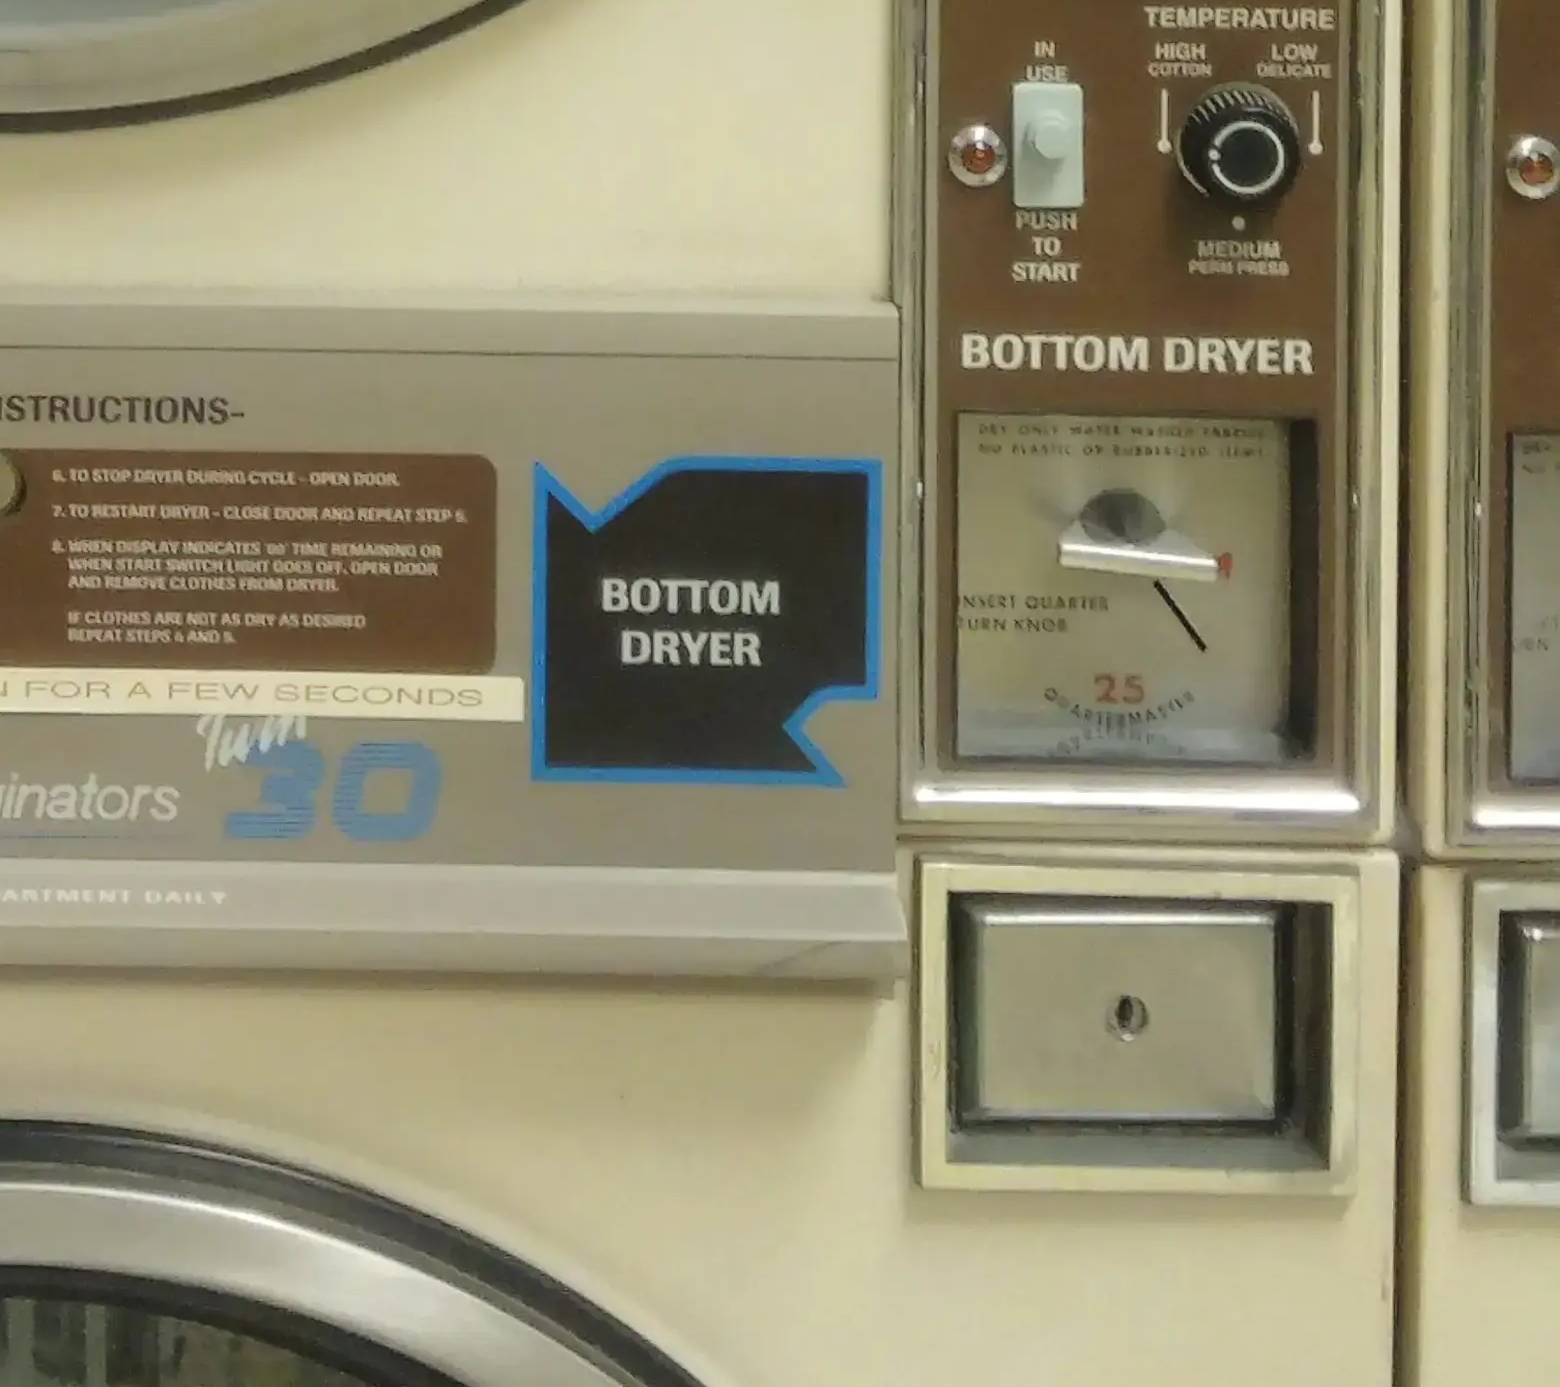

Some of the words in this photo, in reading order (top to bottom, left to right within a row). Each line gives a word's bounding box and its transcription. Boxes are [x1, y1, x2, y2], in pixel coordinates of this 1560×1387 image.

[1144, 6, 1335, 30] TEMPERATURE
[1034, 40, 1055, 58] IN
[1154, 42, 1206, 60] HIGH
[1271, 43, 1318, 61] LOW
[1025, 64, 1069, 83] USE
[1147, 62, 1212, 77] COTTON
[1256, 62, 1332, 79] DELICATE
[1015, 211, 1078, 231] PUSH
[1032, 236, 1061, 256] TO
[1197, 241, 1281, 259] MEDIUM
[1011, 261, 1080, 282] START
[1188, 259, 1233, 275] PERM
[1237, 260, 1289, 276] PRESS
[961, 333, 1148, 372] BOTTOM
[1164, 336, 1313, 375] DRYER
[602, 578, 780, 615] BOTTOM
[1025, 596, 1109, 612] QUARTER
[621, 630, 761, 666] DRYER
[25, 682, 111, 702] FOR
[127, 682, 151, 703] A
[168, 682, 260, 704] FEW
[275, 683, 483, 706] SECONDS
[1093, 674, 1145, 705] 25
[223, 739, 444, 842] 30
[144, 891, 227, 906] DAILY
